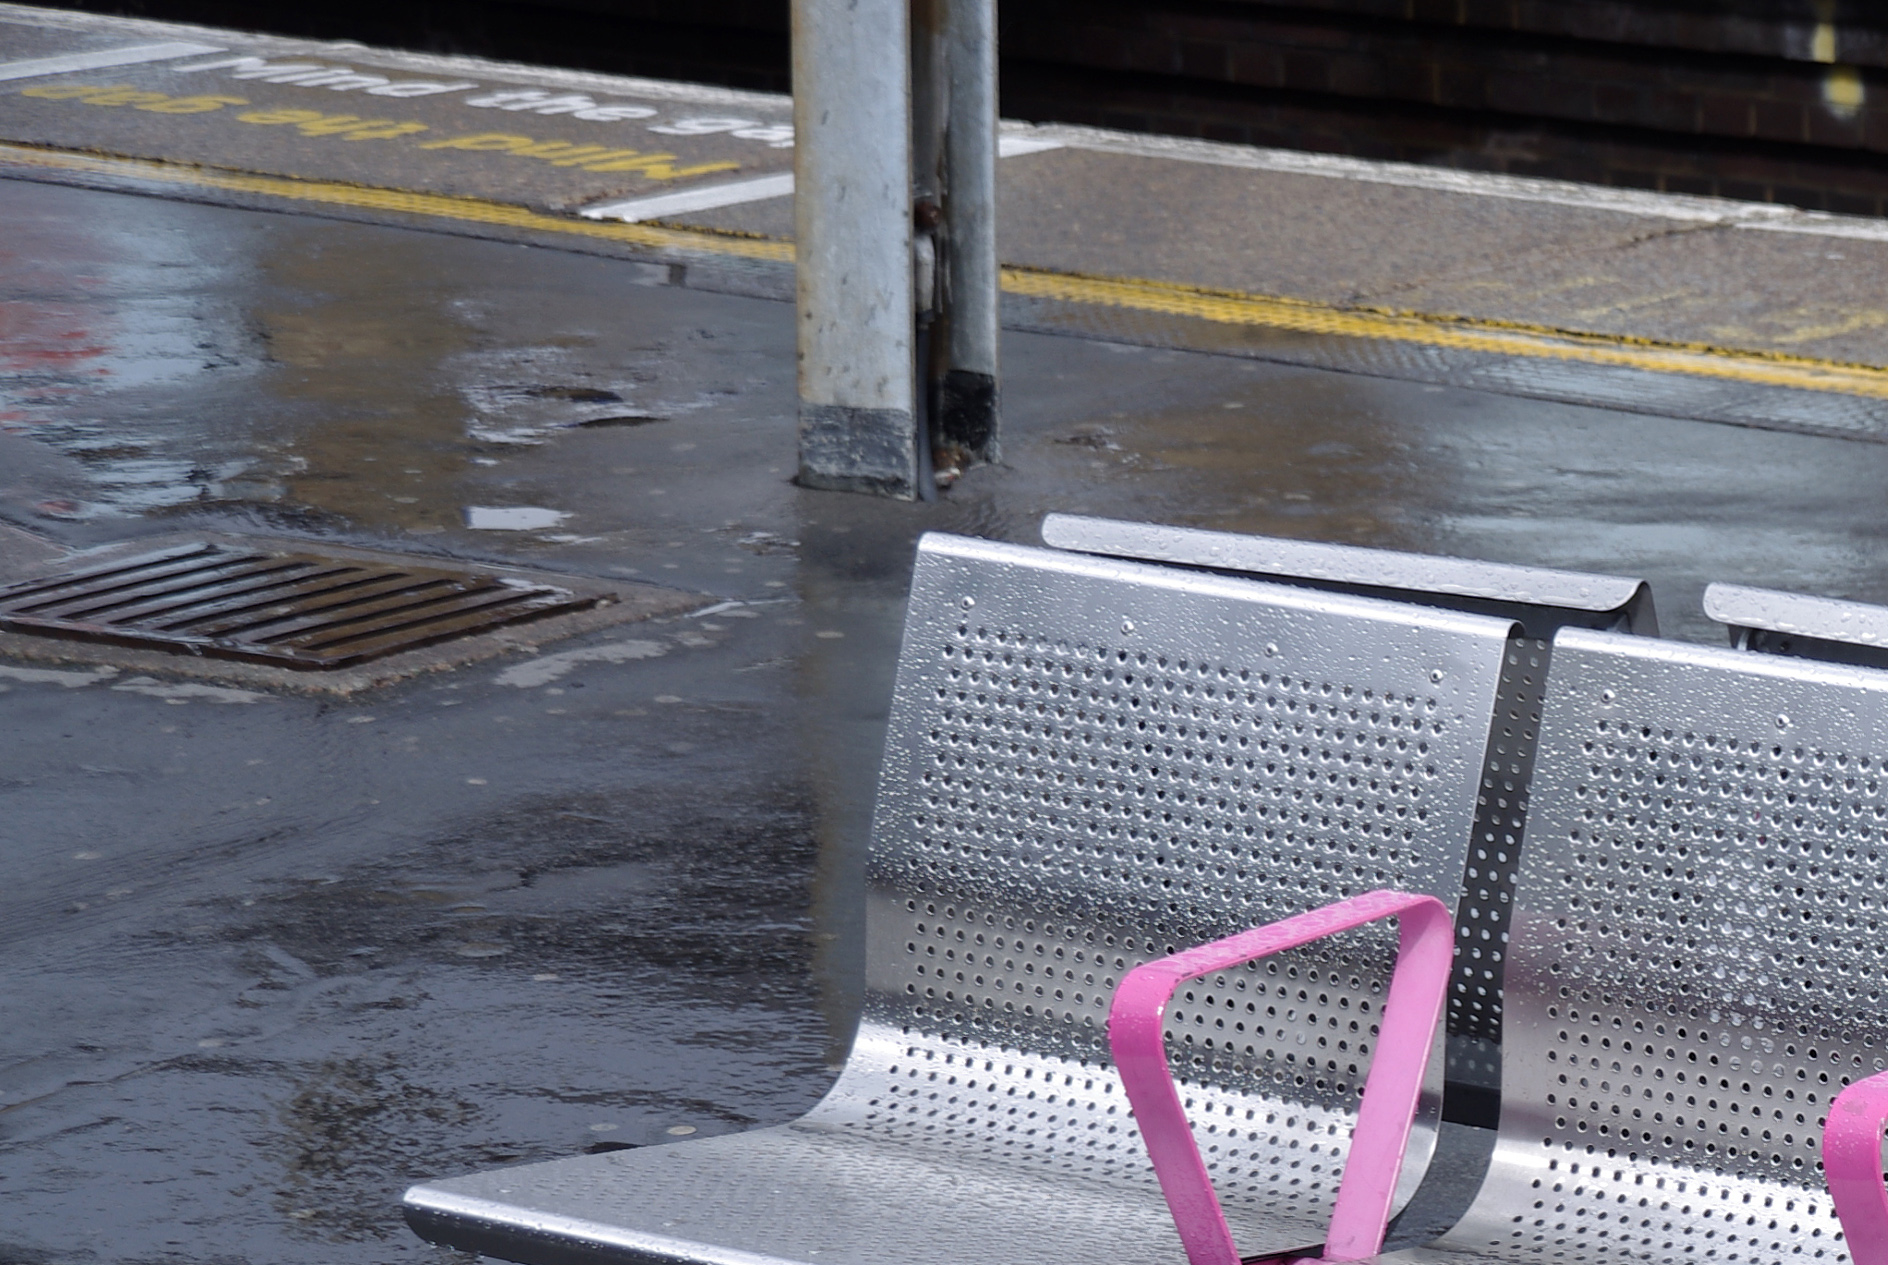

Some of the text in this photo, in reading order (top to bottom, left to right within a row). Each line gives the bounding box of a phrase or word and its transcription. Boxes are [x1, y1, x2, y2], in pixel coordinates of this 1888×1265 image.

[21, 84, 741, 180] Mind the gap
[171, 57, 794, 147] Mind the ga
